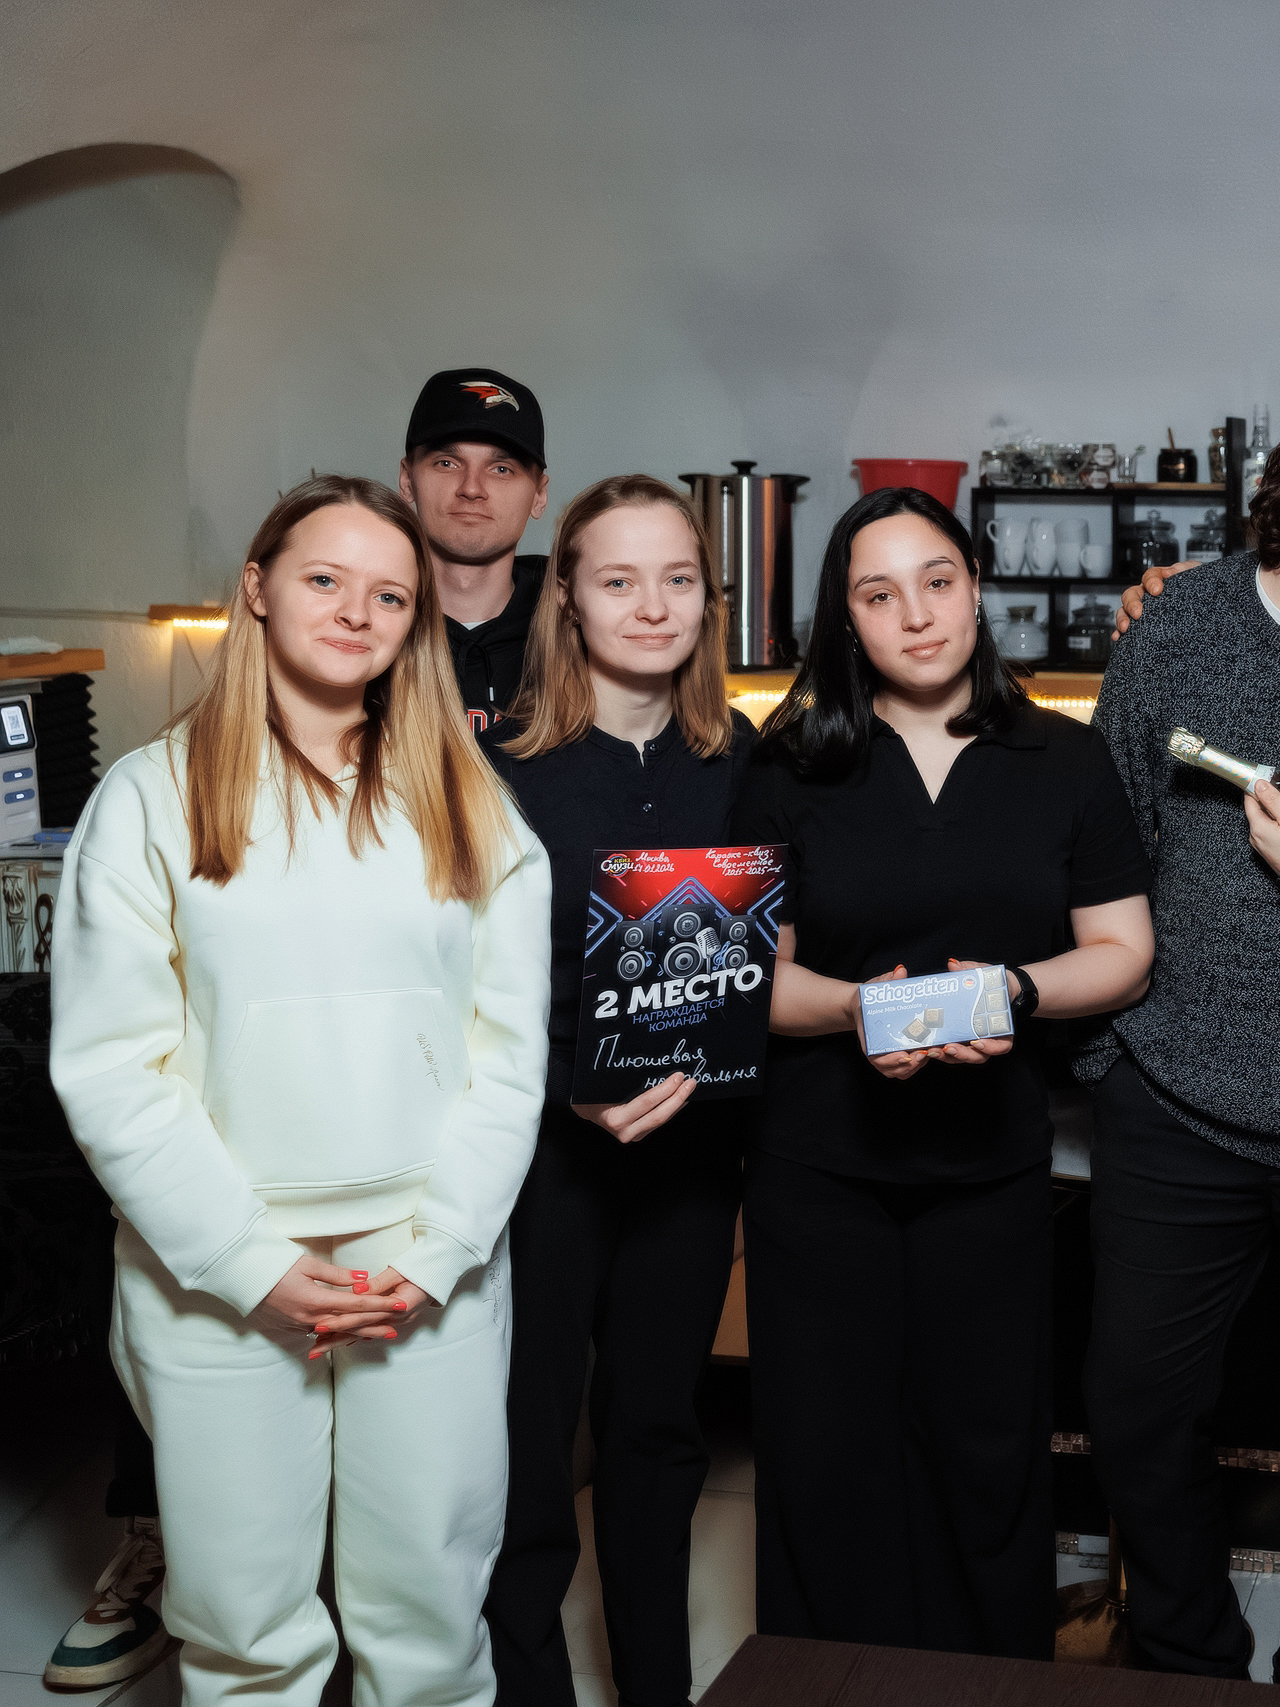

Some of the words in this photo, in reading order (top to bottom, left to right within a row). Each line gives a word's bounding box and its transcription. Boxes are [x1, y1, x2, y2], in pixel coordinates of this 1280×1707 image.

[600, 859, 634, 872] Смузи
[635, 851, 670, 863] Москва
[595, 990, 619, 1019] 2
[627, 963, 763, 1014] МЕСТО
[864, 977, 959, 1005] Schogetten
[633, 997, 726, 1025] НАГРАЖДАЕТСЯ
[896, 1003, 923, 1012] Chocolate
[648, 1013, 708, 1033] КОМАНДА
[594, 1033, 706, 1070] Плюшевая
